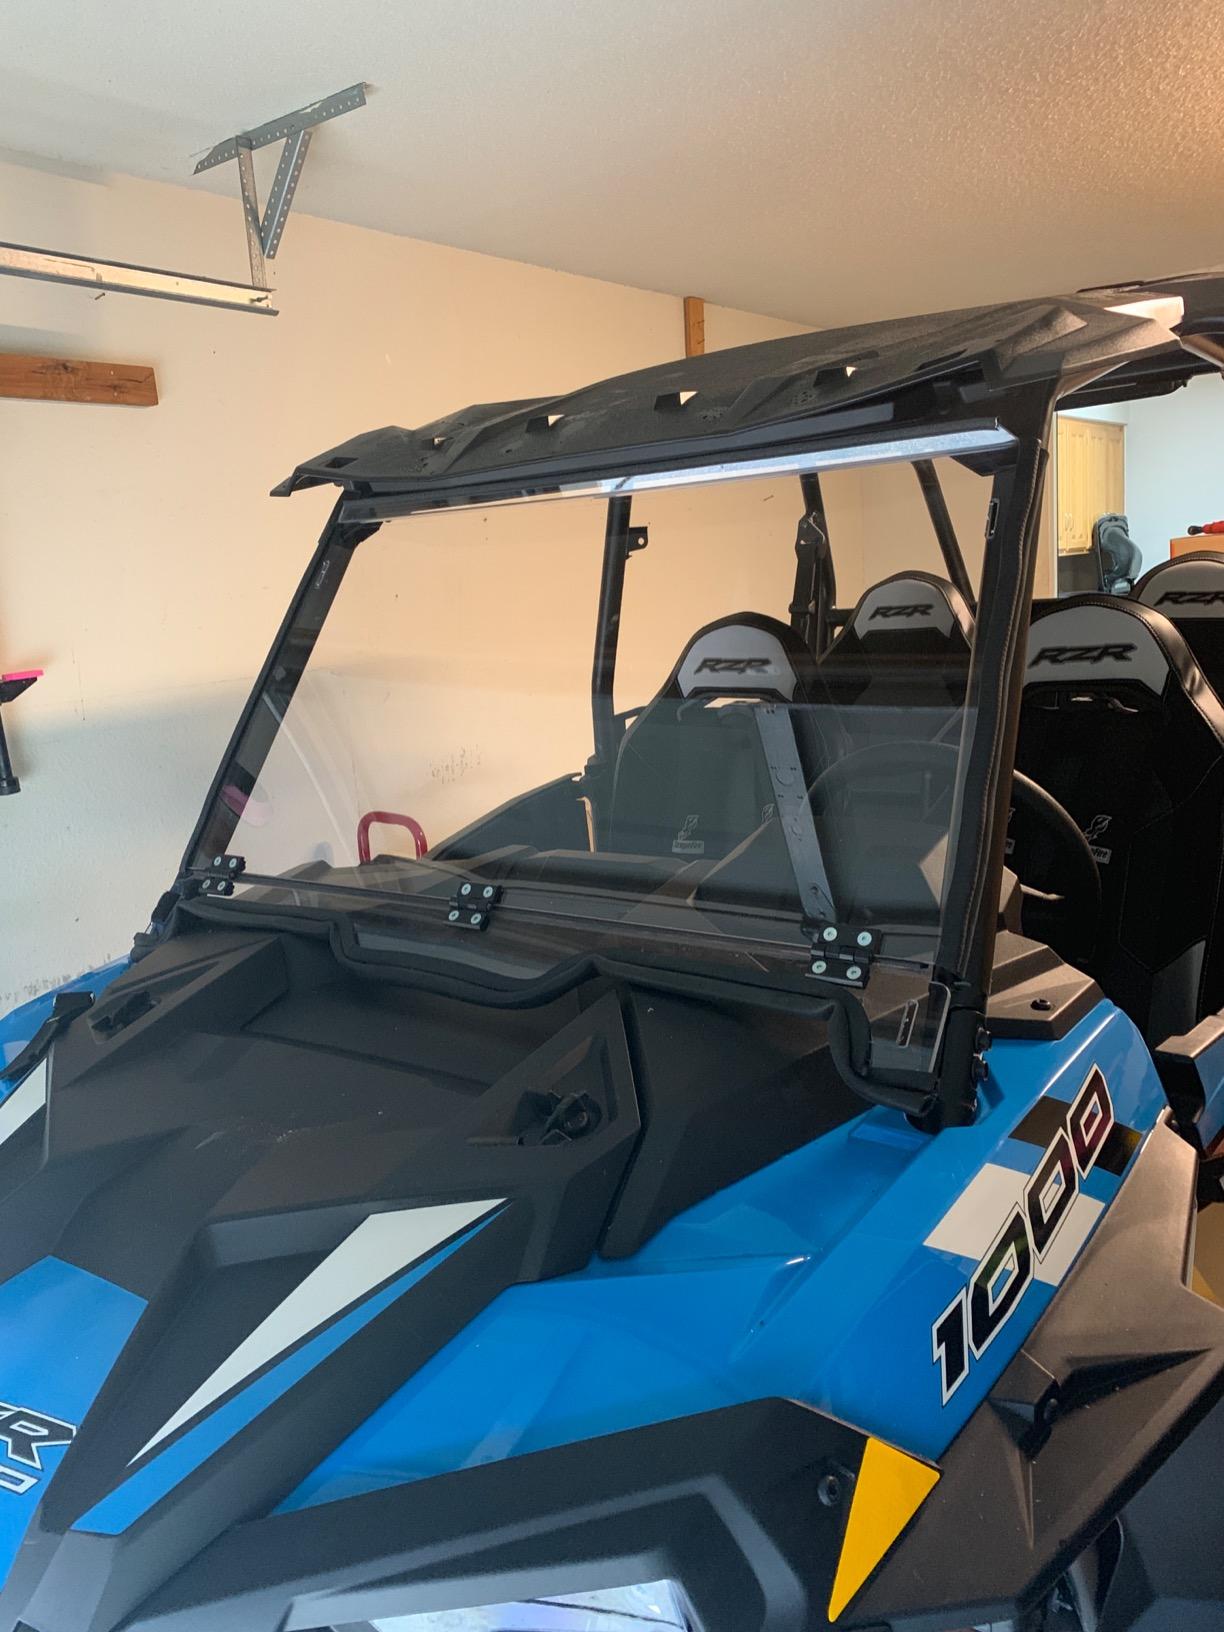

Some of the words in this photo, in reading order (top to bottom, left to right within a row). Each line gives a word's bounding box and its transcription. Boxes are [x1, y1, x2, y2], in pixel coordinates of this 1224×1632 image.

[867, 603, 934, 621] RZR
[694, 658, 773, 675] RZR
[1027, 643, 1138, 669] RZR
[931, 1062, 1115, 1407] 1000
